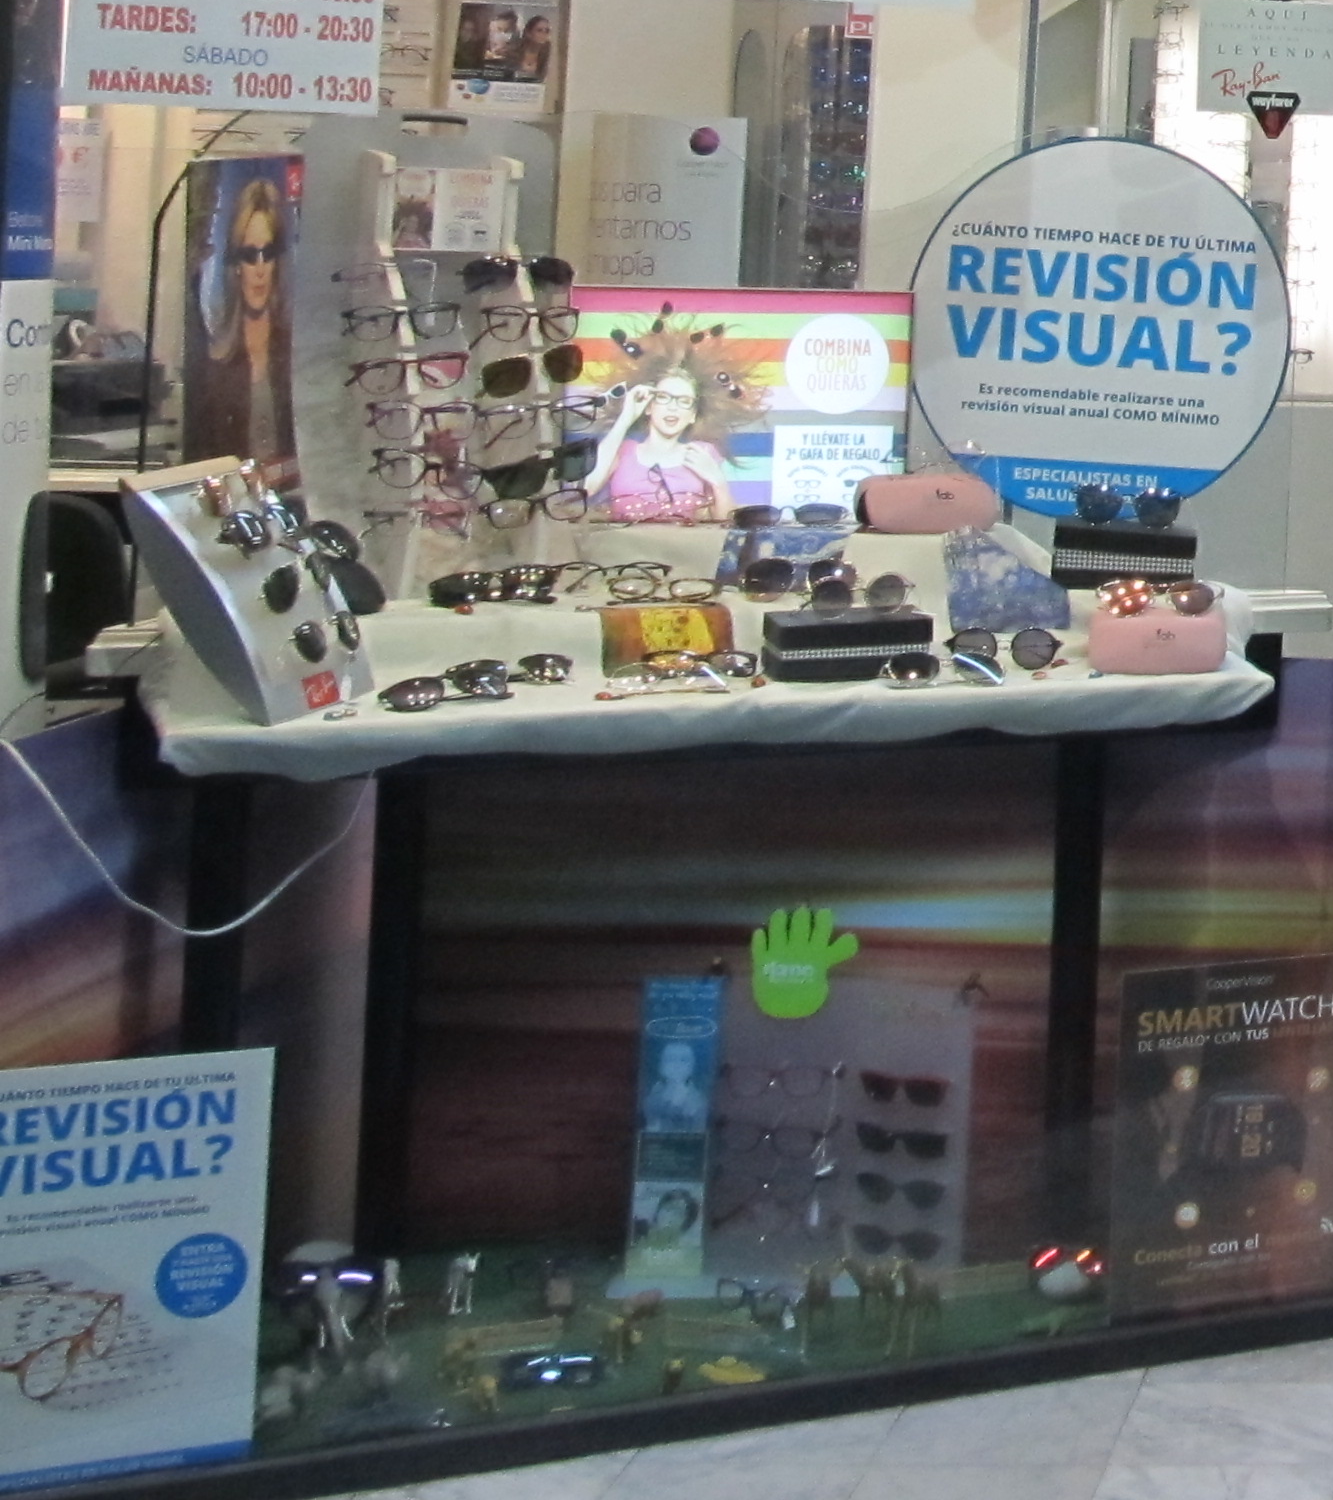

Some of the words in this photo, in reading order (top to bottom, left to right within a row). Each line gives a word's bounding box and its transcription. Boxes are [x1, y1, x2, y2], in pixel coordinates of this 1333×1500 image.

[97, 4, 197, 33] TARDES:
[241, 11, 298, 39] 17:00
[317, 15, 374, 43] 20:30
[183, 45, 268, 67] SÁBADO
[952, 220, 1028, 238] ¿CUÁNTO
[1033, 226, 1094, 243] TIEMPO
[1099, 231, 1140, 247] HACE
[1145, 234, 1165, 248] DE
[1170, 235, 1190, 250] TU
[1195, 235, 1257, 254] ÚLTIMA
[946, 244, 1258, 311] REVISIÓN
[804, 338, 872, 357] COMBINA
[946, 304, 1253, 376] VISUAL?
[806, 374, 867, 392] QUIERAS
[978, 383, 993, 395] Es
[997, 384, 1100, 401] recomendable
[1104, 391, 1174, 407] realizarse
[1178, 396, 1205, 408] una
[960, 399, 1019, 412] revisión
[1023, 402, 1065, 416] visual
[1069, 407, 1109, 418] anual
[1112, 409, 1157, 422] COMO
[1161, 410, 1220, 426] MÍNIMO
[802, 434, 808, 446] Y
[811, 431, 850, 446] LLÉVATE
[853, 434, 865, 446] LA
[1138, 1040, 1153, 1053] DE
[1214, 1031, 1241, 1044] CON
[1246, 1028, 1269, 1041] TUS
[143, 1079, 159, 1090] DE
[165, 1077, 181, 1088] TU
[1208, 1240, 1239, 1255] con
[1245, 1233, 1259, 1249] el
